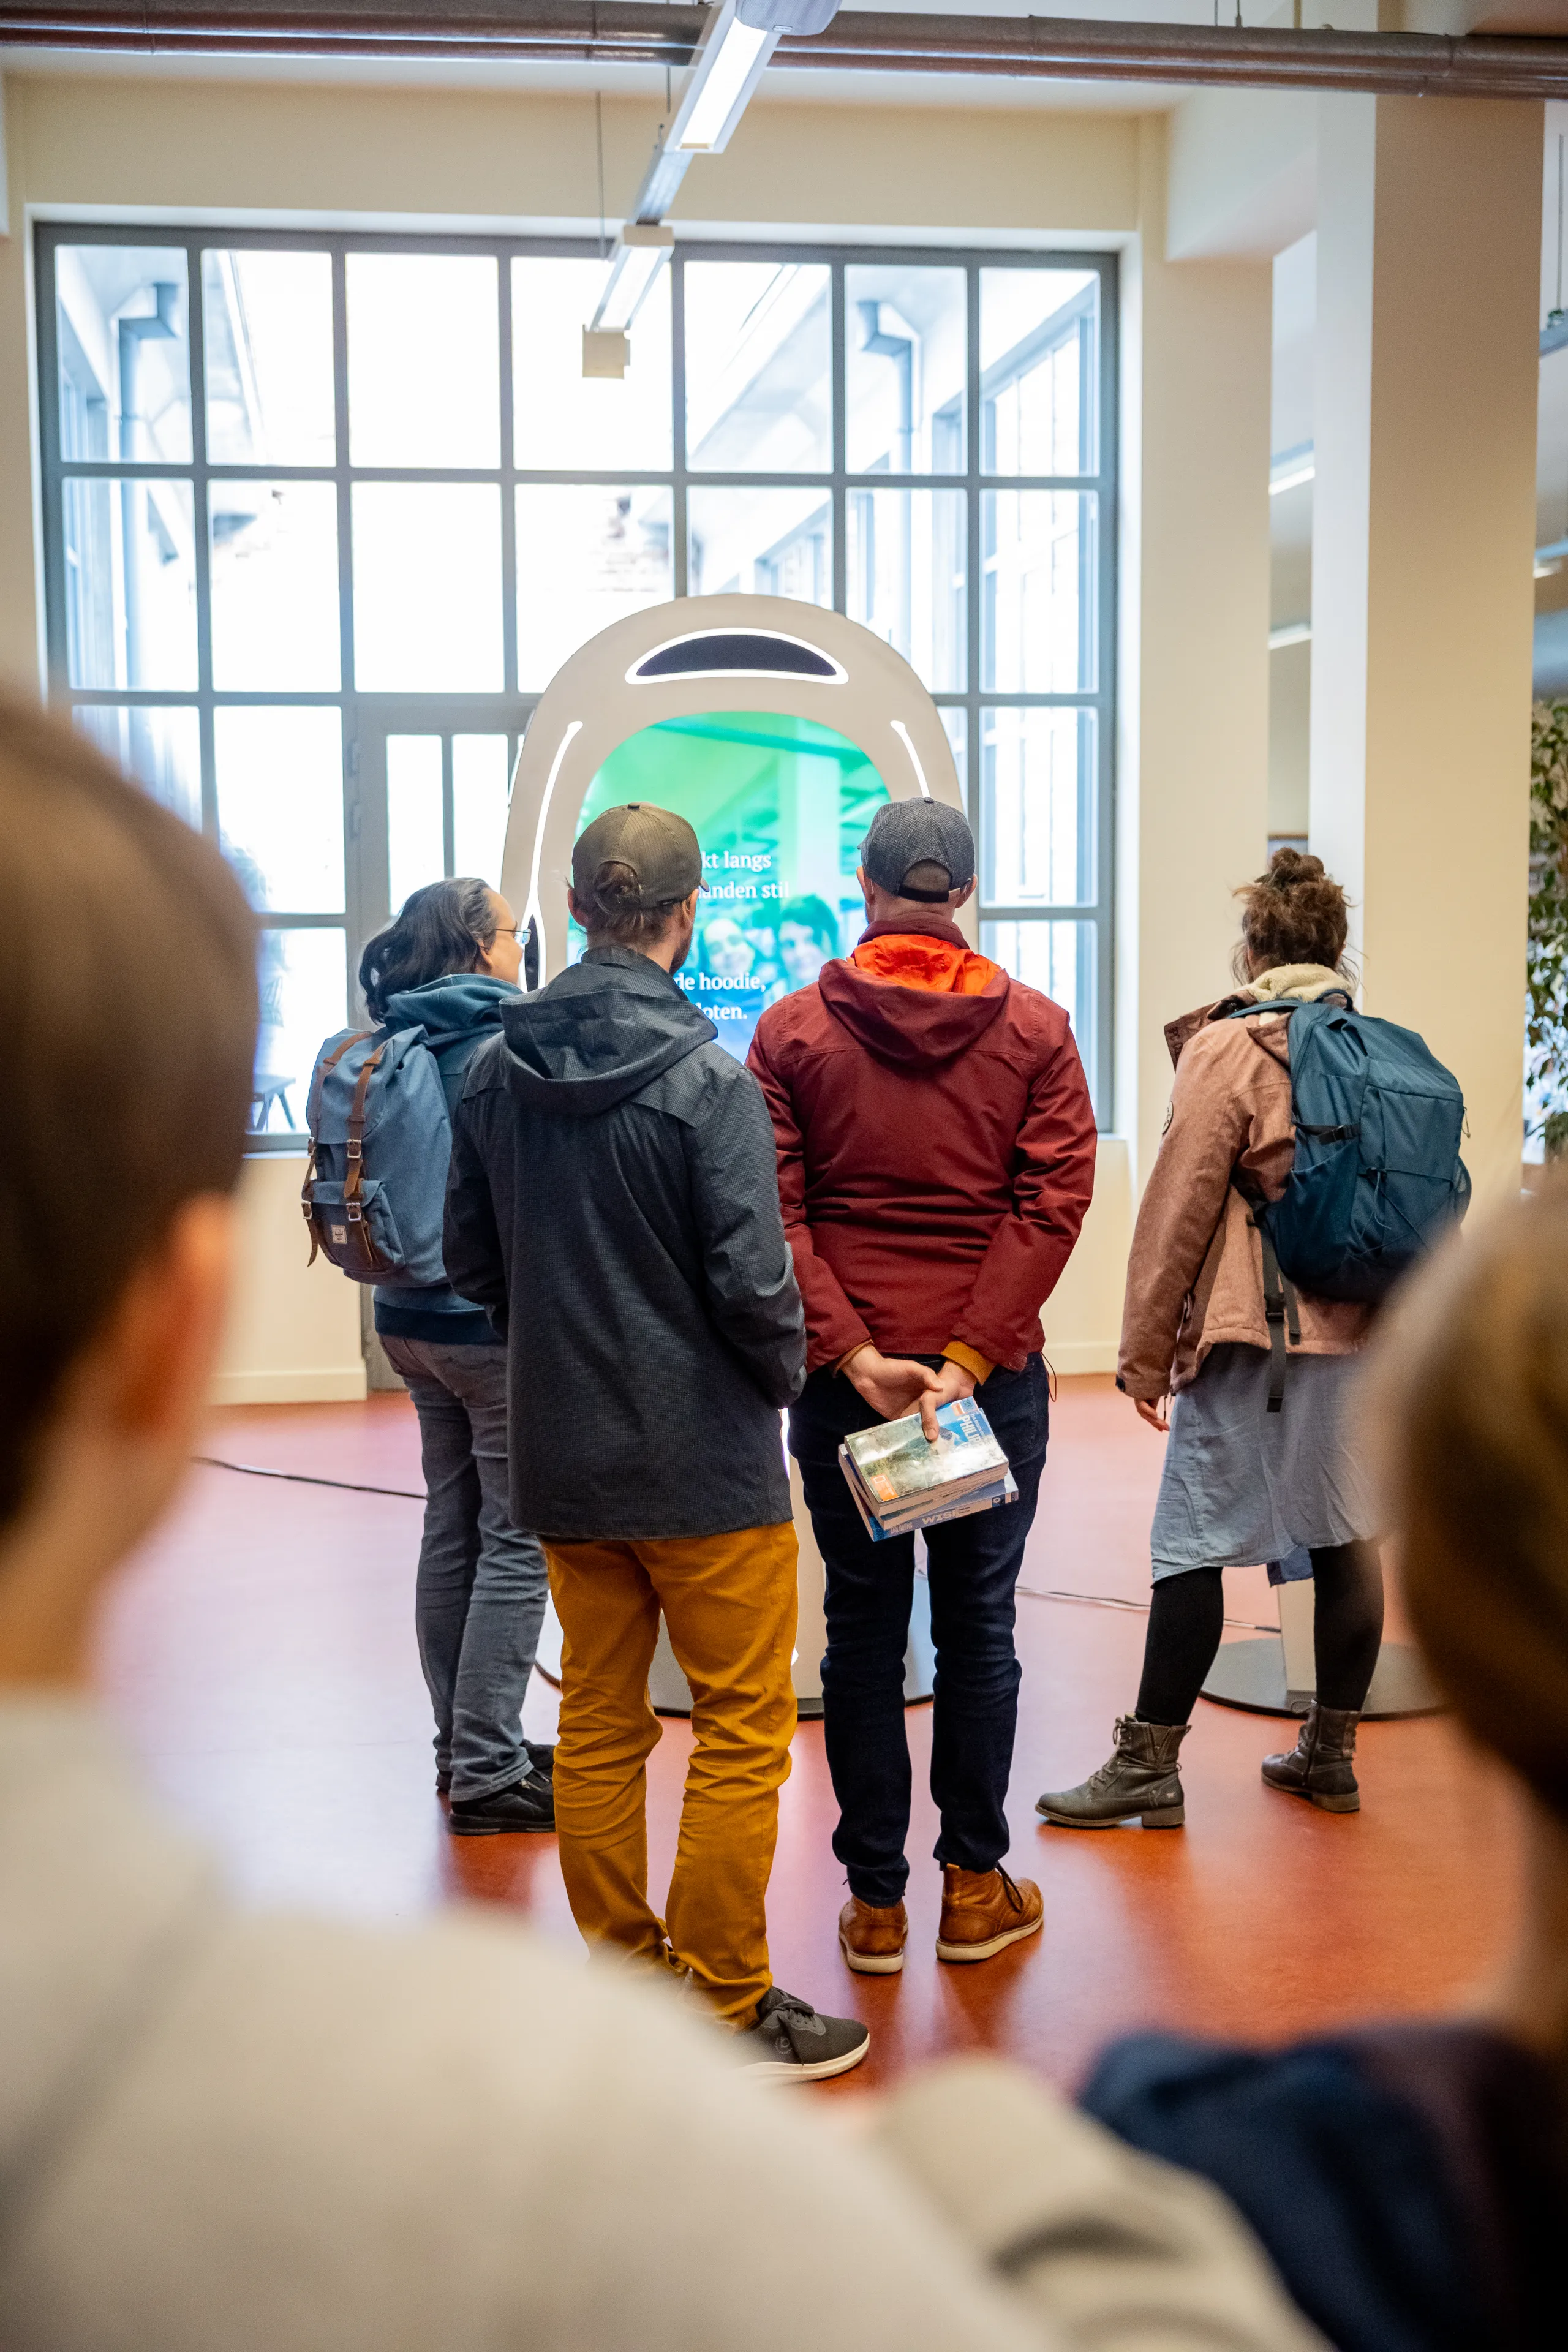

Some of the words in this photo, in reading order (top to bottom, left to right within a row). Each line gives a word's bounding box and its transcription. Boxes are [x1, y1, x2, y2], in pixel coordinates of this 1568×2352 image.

[724, 850, 772, 872] langs
[761, 881, 790, 899] stil
[699, 971, 766, 992] hoodie,
